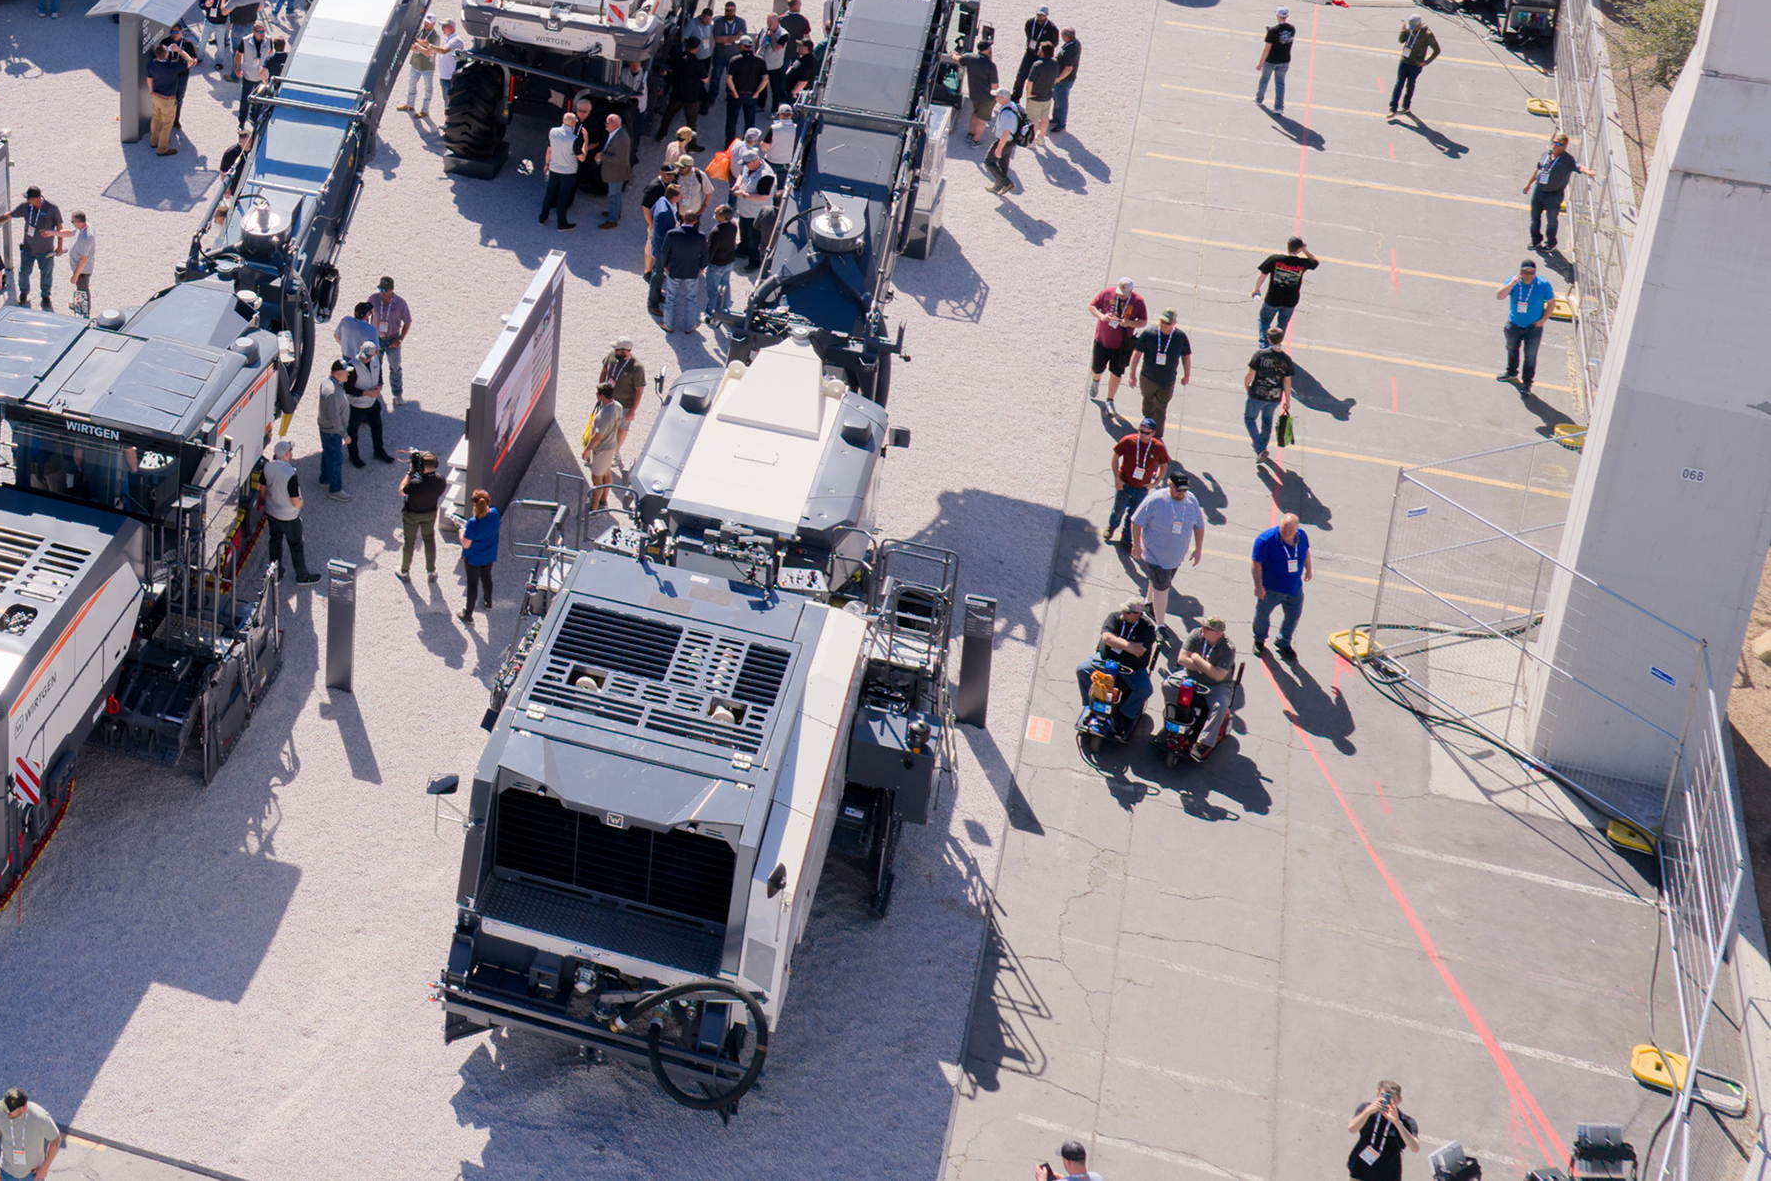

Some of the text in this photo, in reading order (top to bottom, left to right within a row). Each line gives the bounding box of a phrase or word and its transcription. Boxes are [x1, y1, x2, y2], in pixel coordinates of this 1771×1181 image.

[535, 35, 571, 47] WIRTGEN
[66, 420, 119, 441] WIRTGEN
[1682, 468, 1705, 482] 068
[24, 672, 57, 722] WIRTGEN
